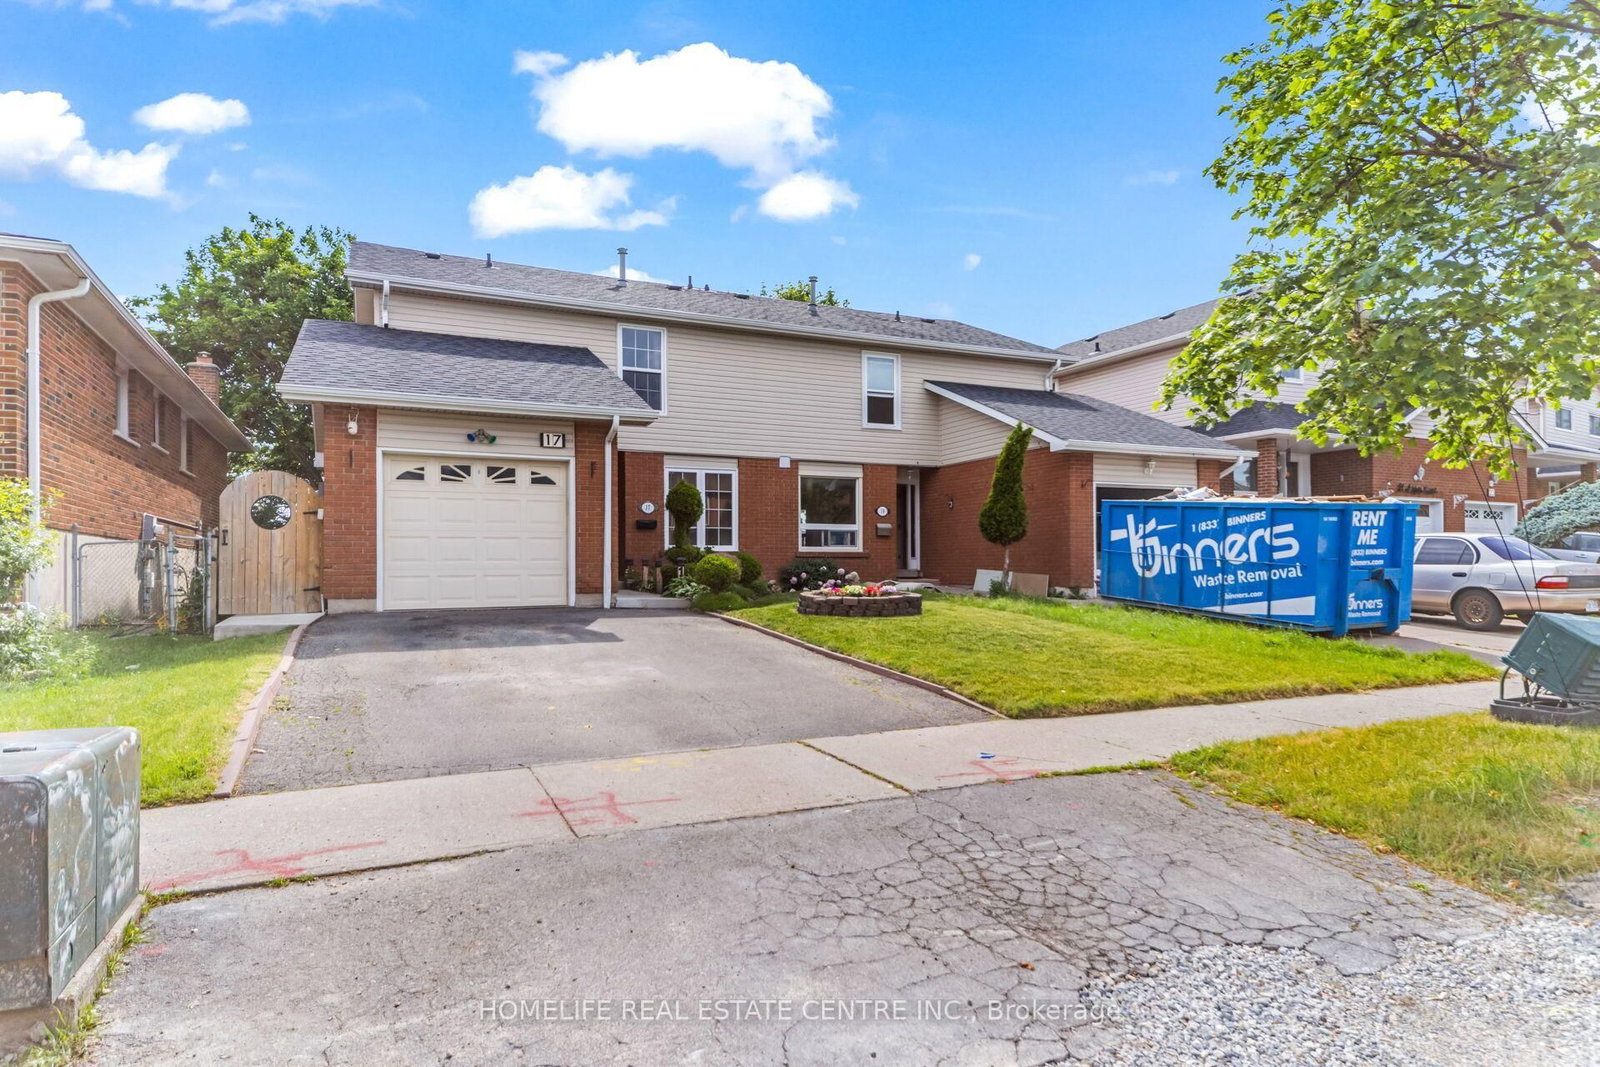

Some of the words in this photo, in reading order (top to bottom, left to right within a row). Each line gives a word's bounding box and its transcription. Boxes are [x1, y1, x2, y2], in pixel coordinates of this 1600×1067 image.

[546, 434, 562, 446] 17
[1191, 523, 1196, 533] 1
[1226, 511, 1267, 527] BINNERS
[1351, 510, 1388, 527] RENT
[1356, 529, 1379, 545] ME
[1365, 548, 1388, 556] BINNERS
[1350, 556, 1384, 566] binners.com
[1193, 573, 1235, 588] Waste
[1237, 563, 1303, 584] Removal
